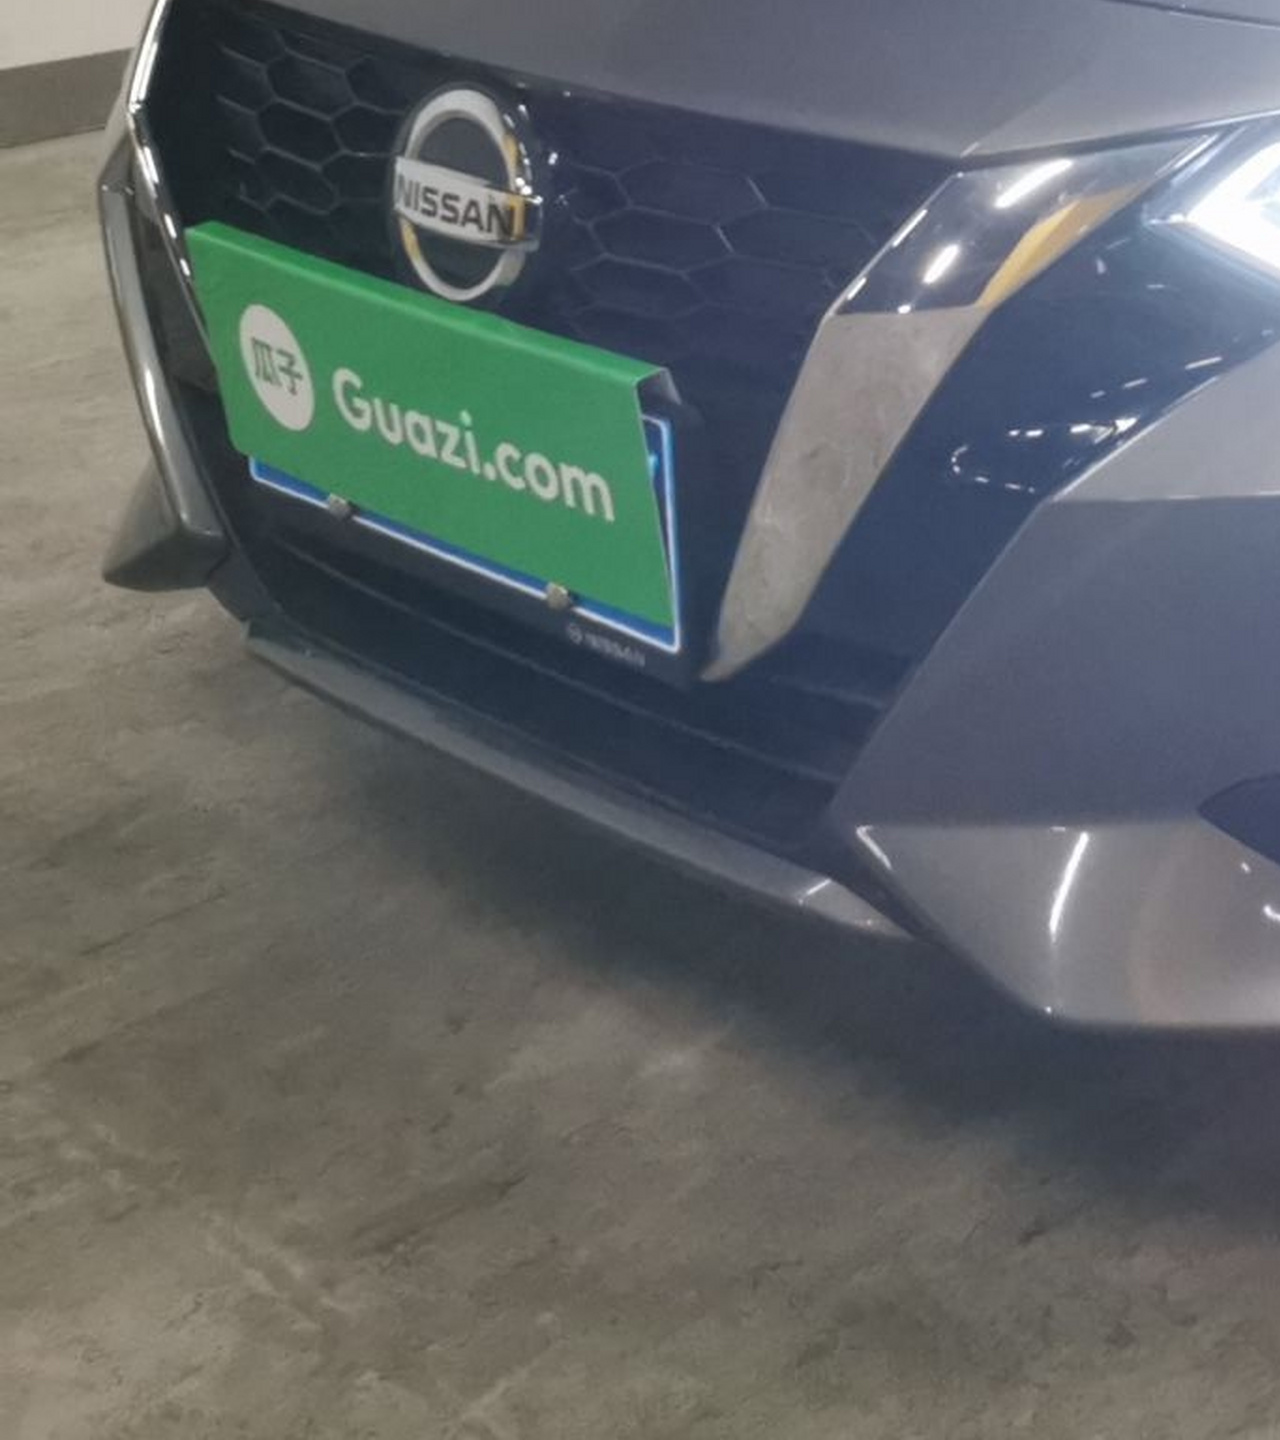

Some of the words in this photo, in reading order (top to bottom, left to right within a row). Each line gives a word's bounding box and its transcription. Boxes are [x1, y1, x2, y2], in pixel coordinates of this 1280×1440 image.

[398, 173, 517, 238] NISSAN
[250, 336, 304, 396] 瓜子
[331, 367, 616, 522] Guazi.com
